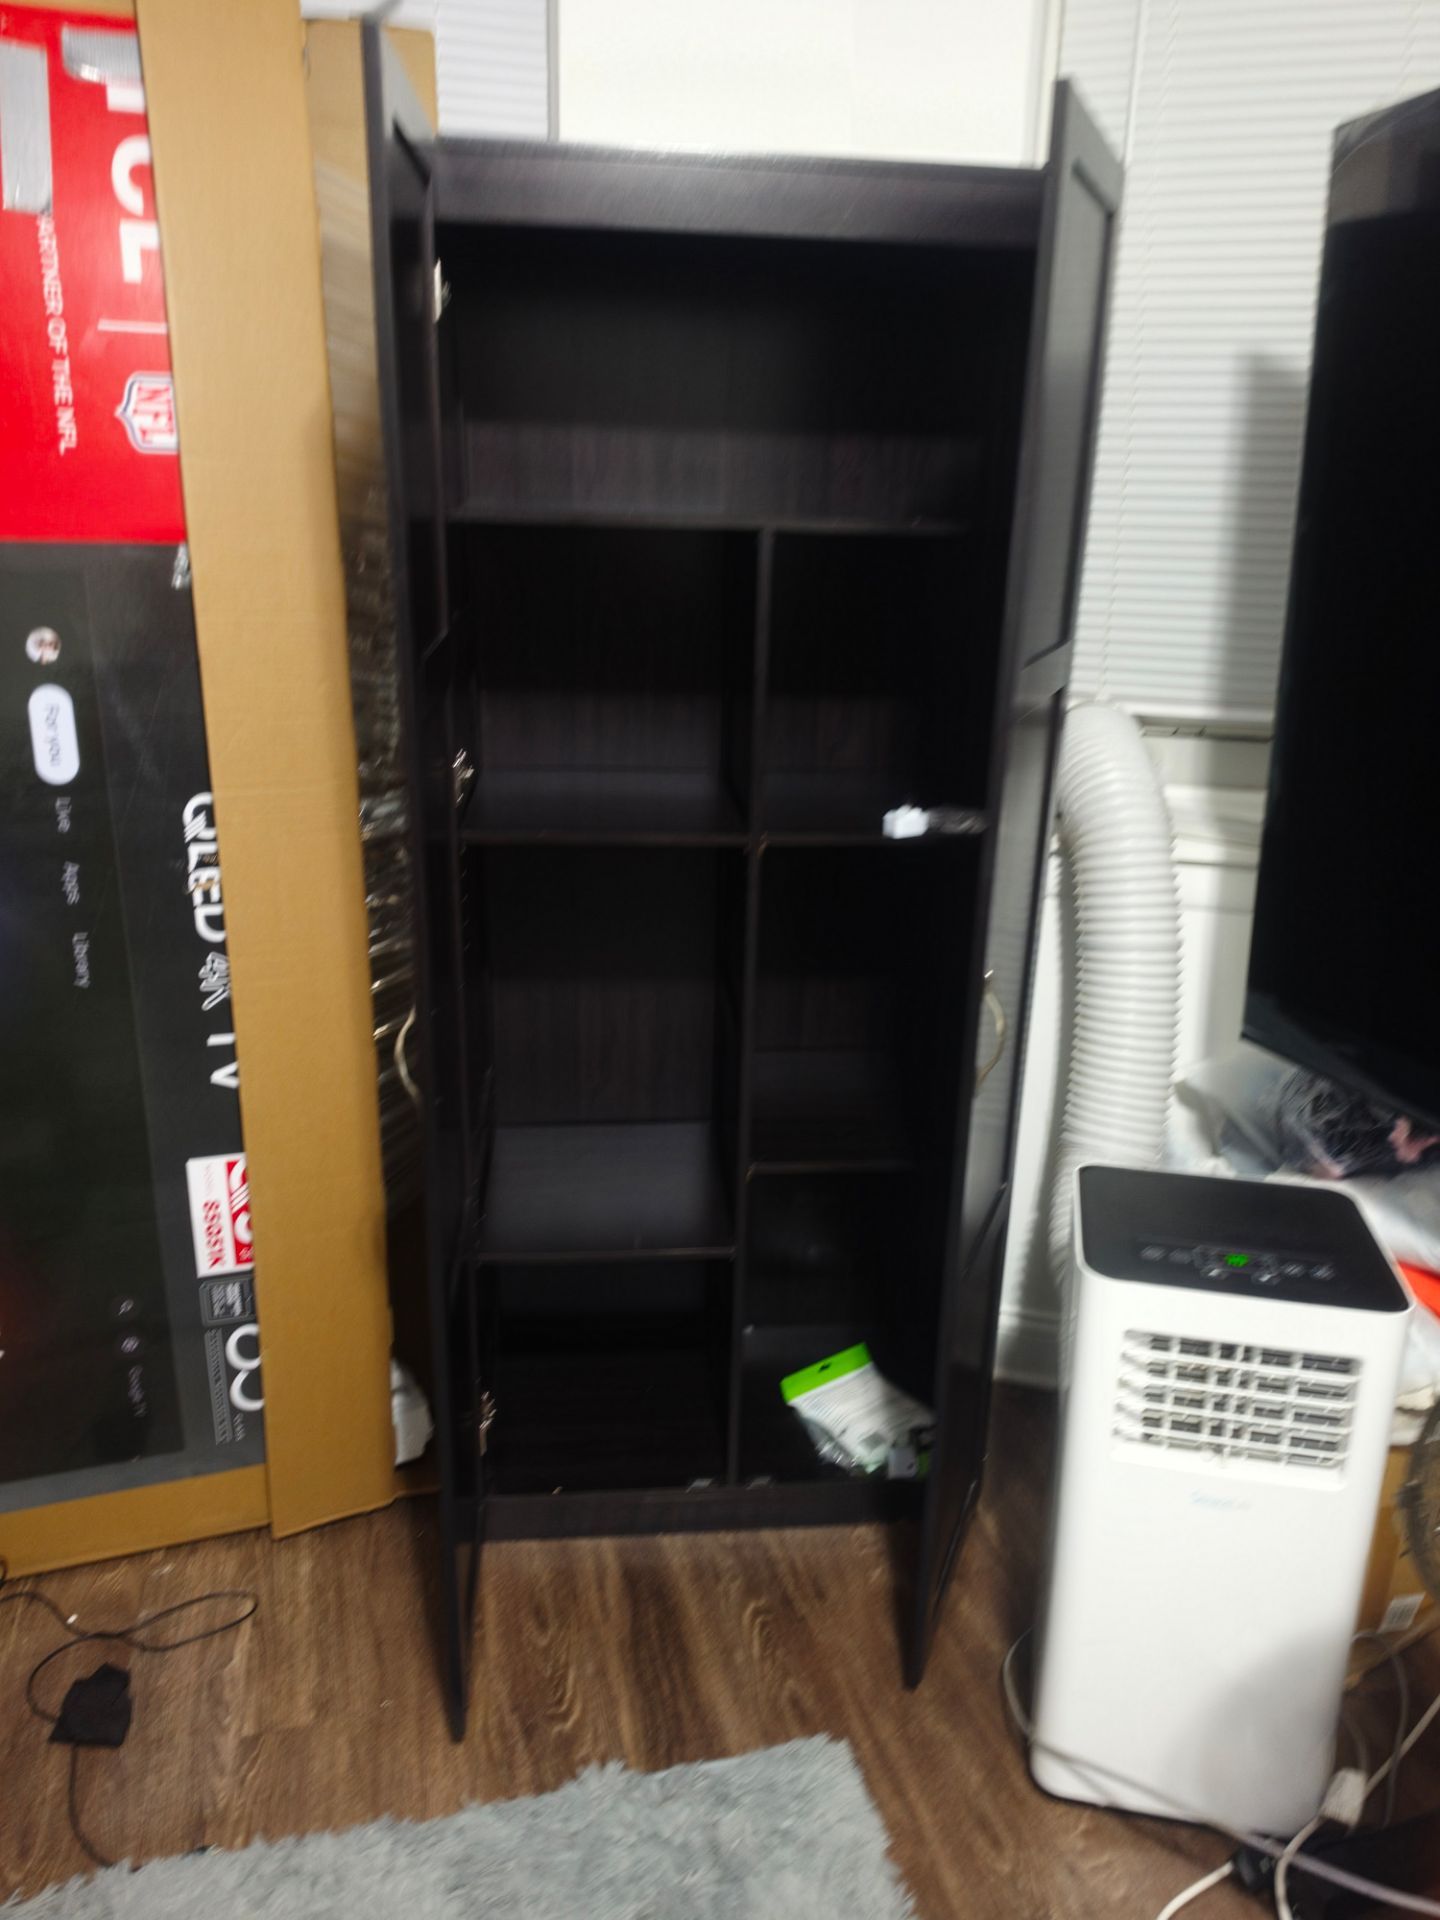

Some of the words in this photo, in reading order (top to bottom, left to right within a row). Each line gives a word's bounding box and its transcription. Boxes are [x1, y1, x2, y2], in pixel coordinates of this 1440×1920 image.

[37, 213, 63, 317] ARTNER
[47, 315, 68, 354] OF
[52, 354, 73, 405] THE
[56, 406, 77, 456] NFL
[132, 380, 177, 444] NFL
[61, 861, 80, 904] Apps
[182, 791, 228, 944] QLED
